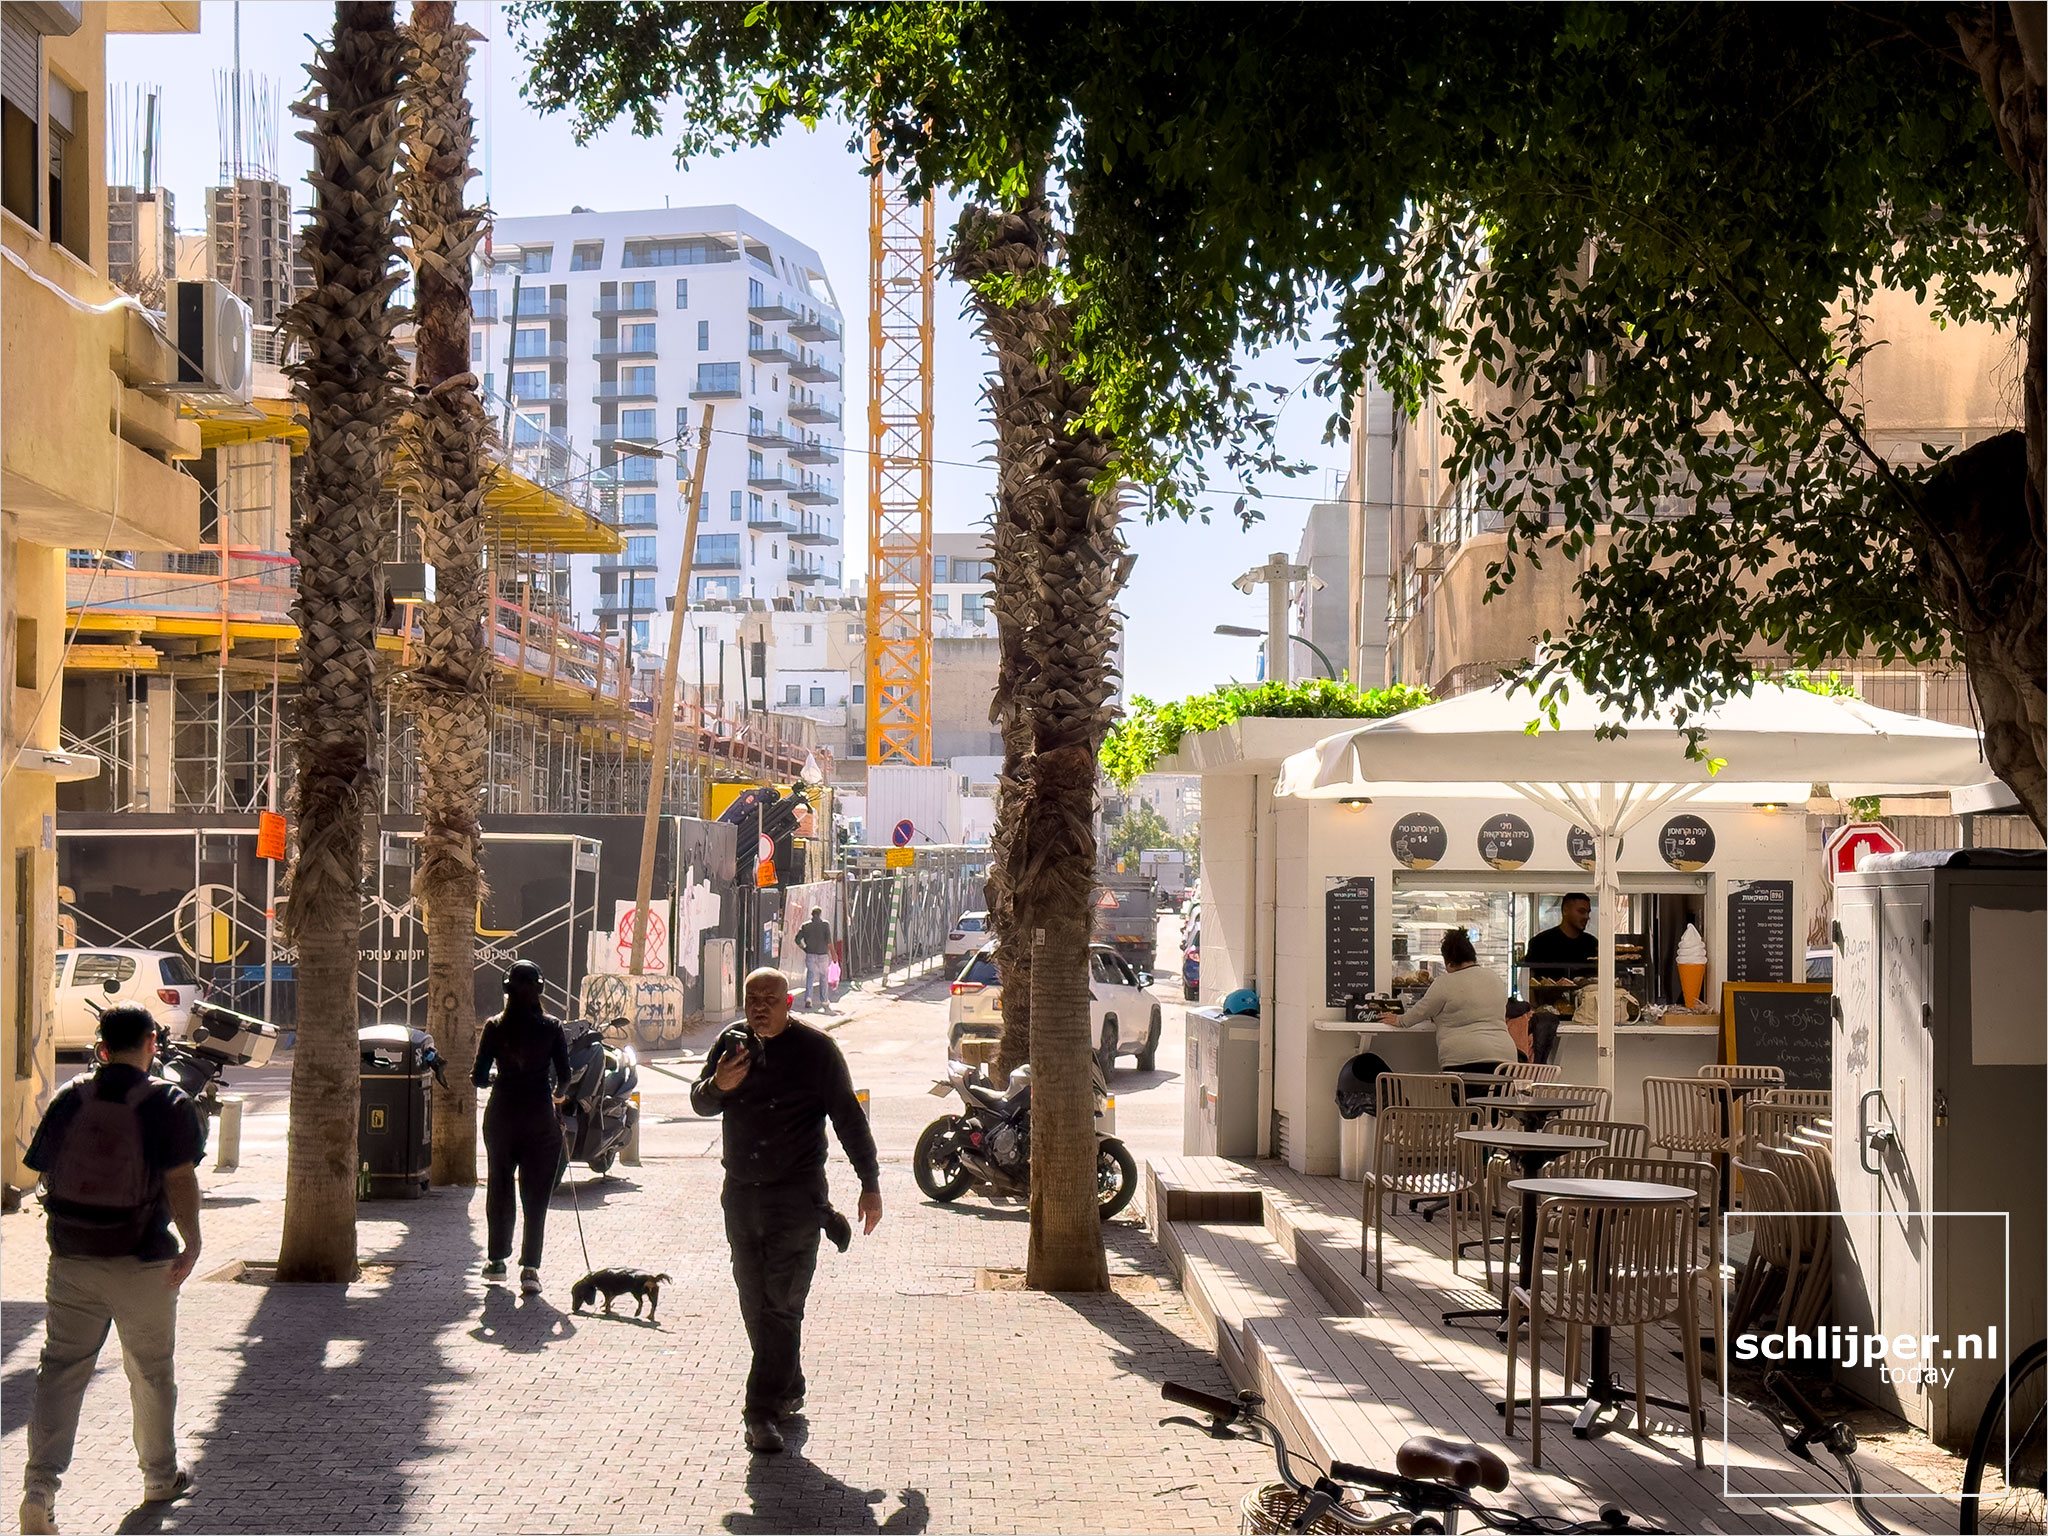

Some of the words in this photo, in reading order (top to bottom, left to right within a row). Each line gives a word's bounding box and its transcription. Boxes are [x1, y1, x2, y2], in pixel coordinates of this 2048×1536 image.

[1398, 825, 1410, 833] טרי
[1410, 825, 1428, 833] סחוט
[1428, 825, 1440, 834] מיץ
[1500, 822, 1512, 830] מיני
[1512, 830, 1529, 838] גלידה
[1667, 827, 1692, 837] וקרואסון
[1692, 827, 1707, 836] קפה
[1417, 835, 1428, 843] 14
[1506, 839, 1512, 847] 4
[1685, 837, 1696, 845] 26
[1742, 894, 1769, 902] משקאות
